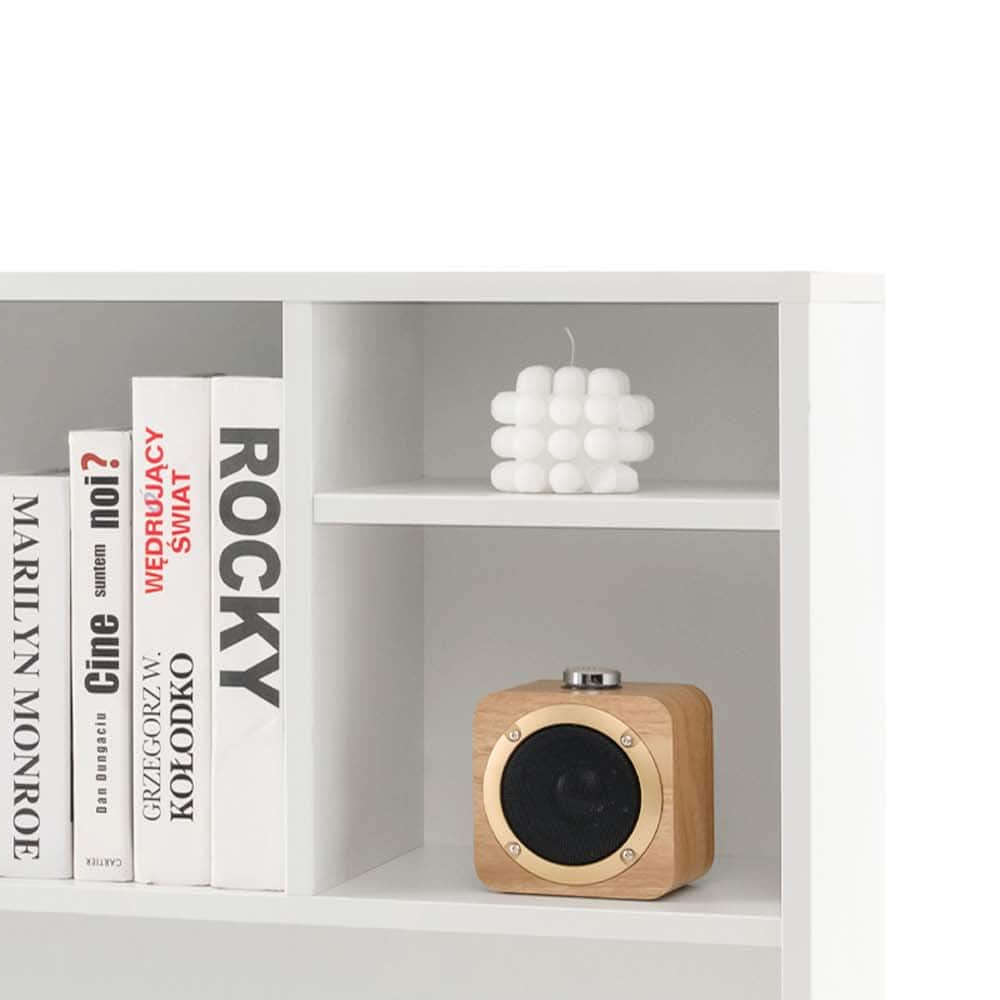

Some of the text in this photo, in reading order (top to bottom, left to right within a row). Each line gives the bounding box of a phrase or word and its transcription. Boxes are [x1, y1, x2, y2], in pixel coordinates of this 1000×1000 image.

[93, 544, 106, 597] suntem
[166, 469, 191, 554] ŚWIAT
[219, 427, 282, 710] ROCKY
[12, 494, 41, 861] MARILYN MONROE
[84, 614, 120, 694] Cine
[94, 712, 108, 814] Dan Dungaciu
[142, 651, 161, 822] GRZEGORZ W.
[169, 652, 194, 822] KOŁODKO
